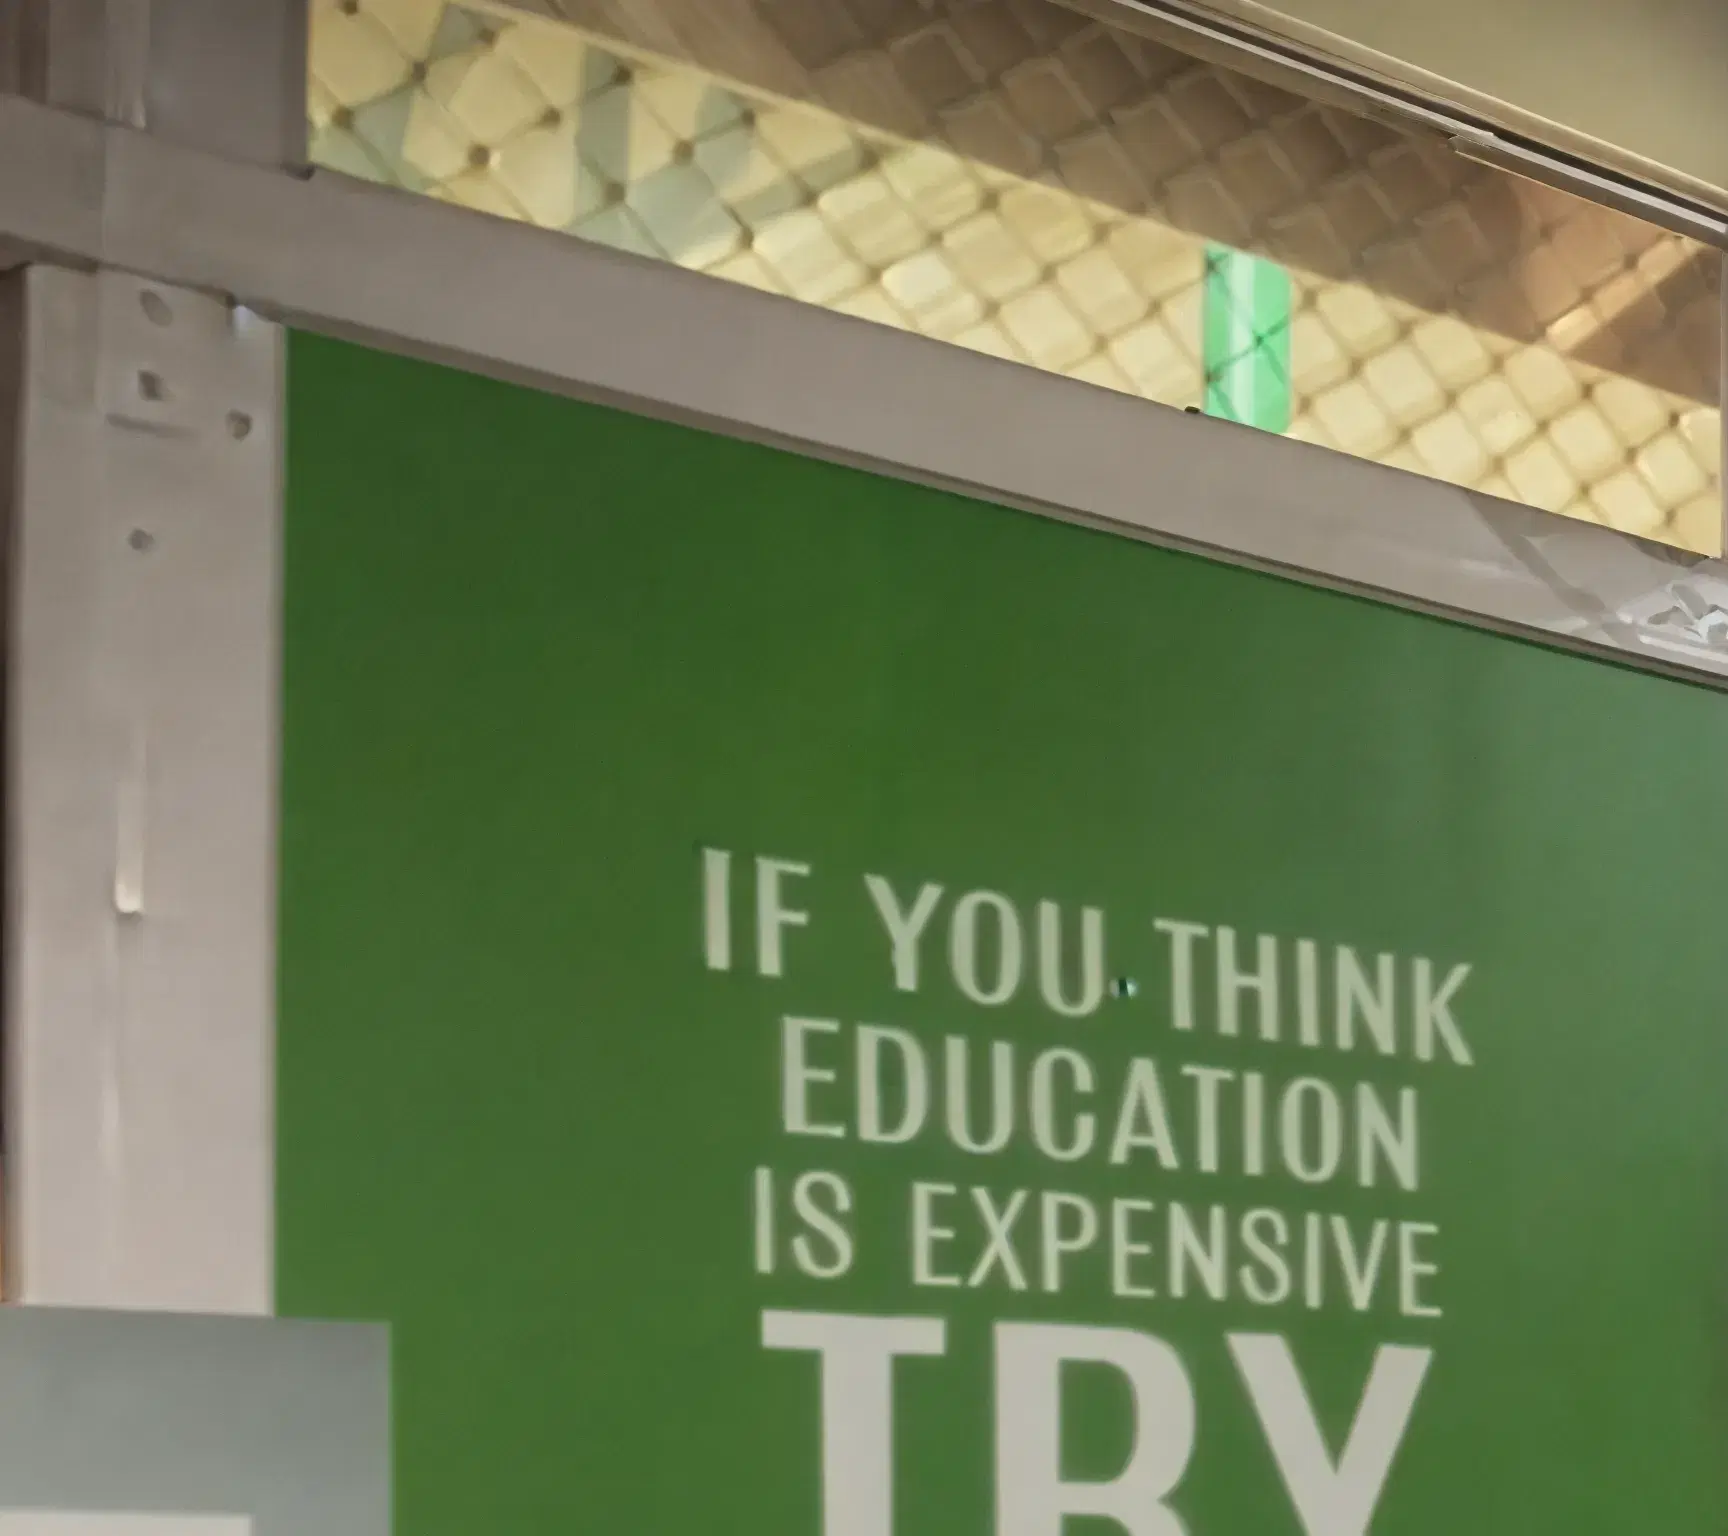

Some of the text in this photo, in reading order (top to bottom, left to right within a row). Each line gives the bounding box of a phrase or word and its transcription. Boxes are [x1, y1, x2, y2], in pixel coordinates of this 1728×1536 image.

[703, 847, 1474, 1066] IF YOU THINK
[781, 1015, 1419, 1192] EDUCATION
[754, 1166, 1444, 1318] IS EXPENSIVE
